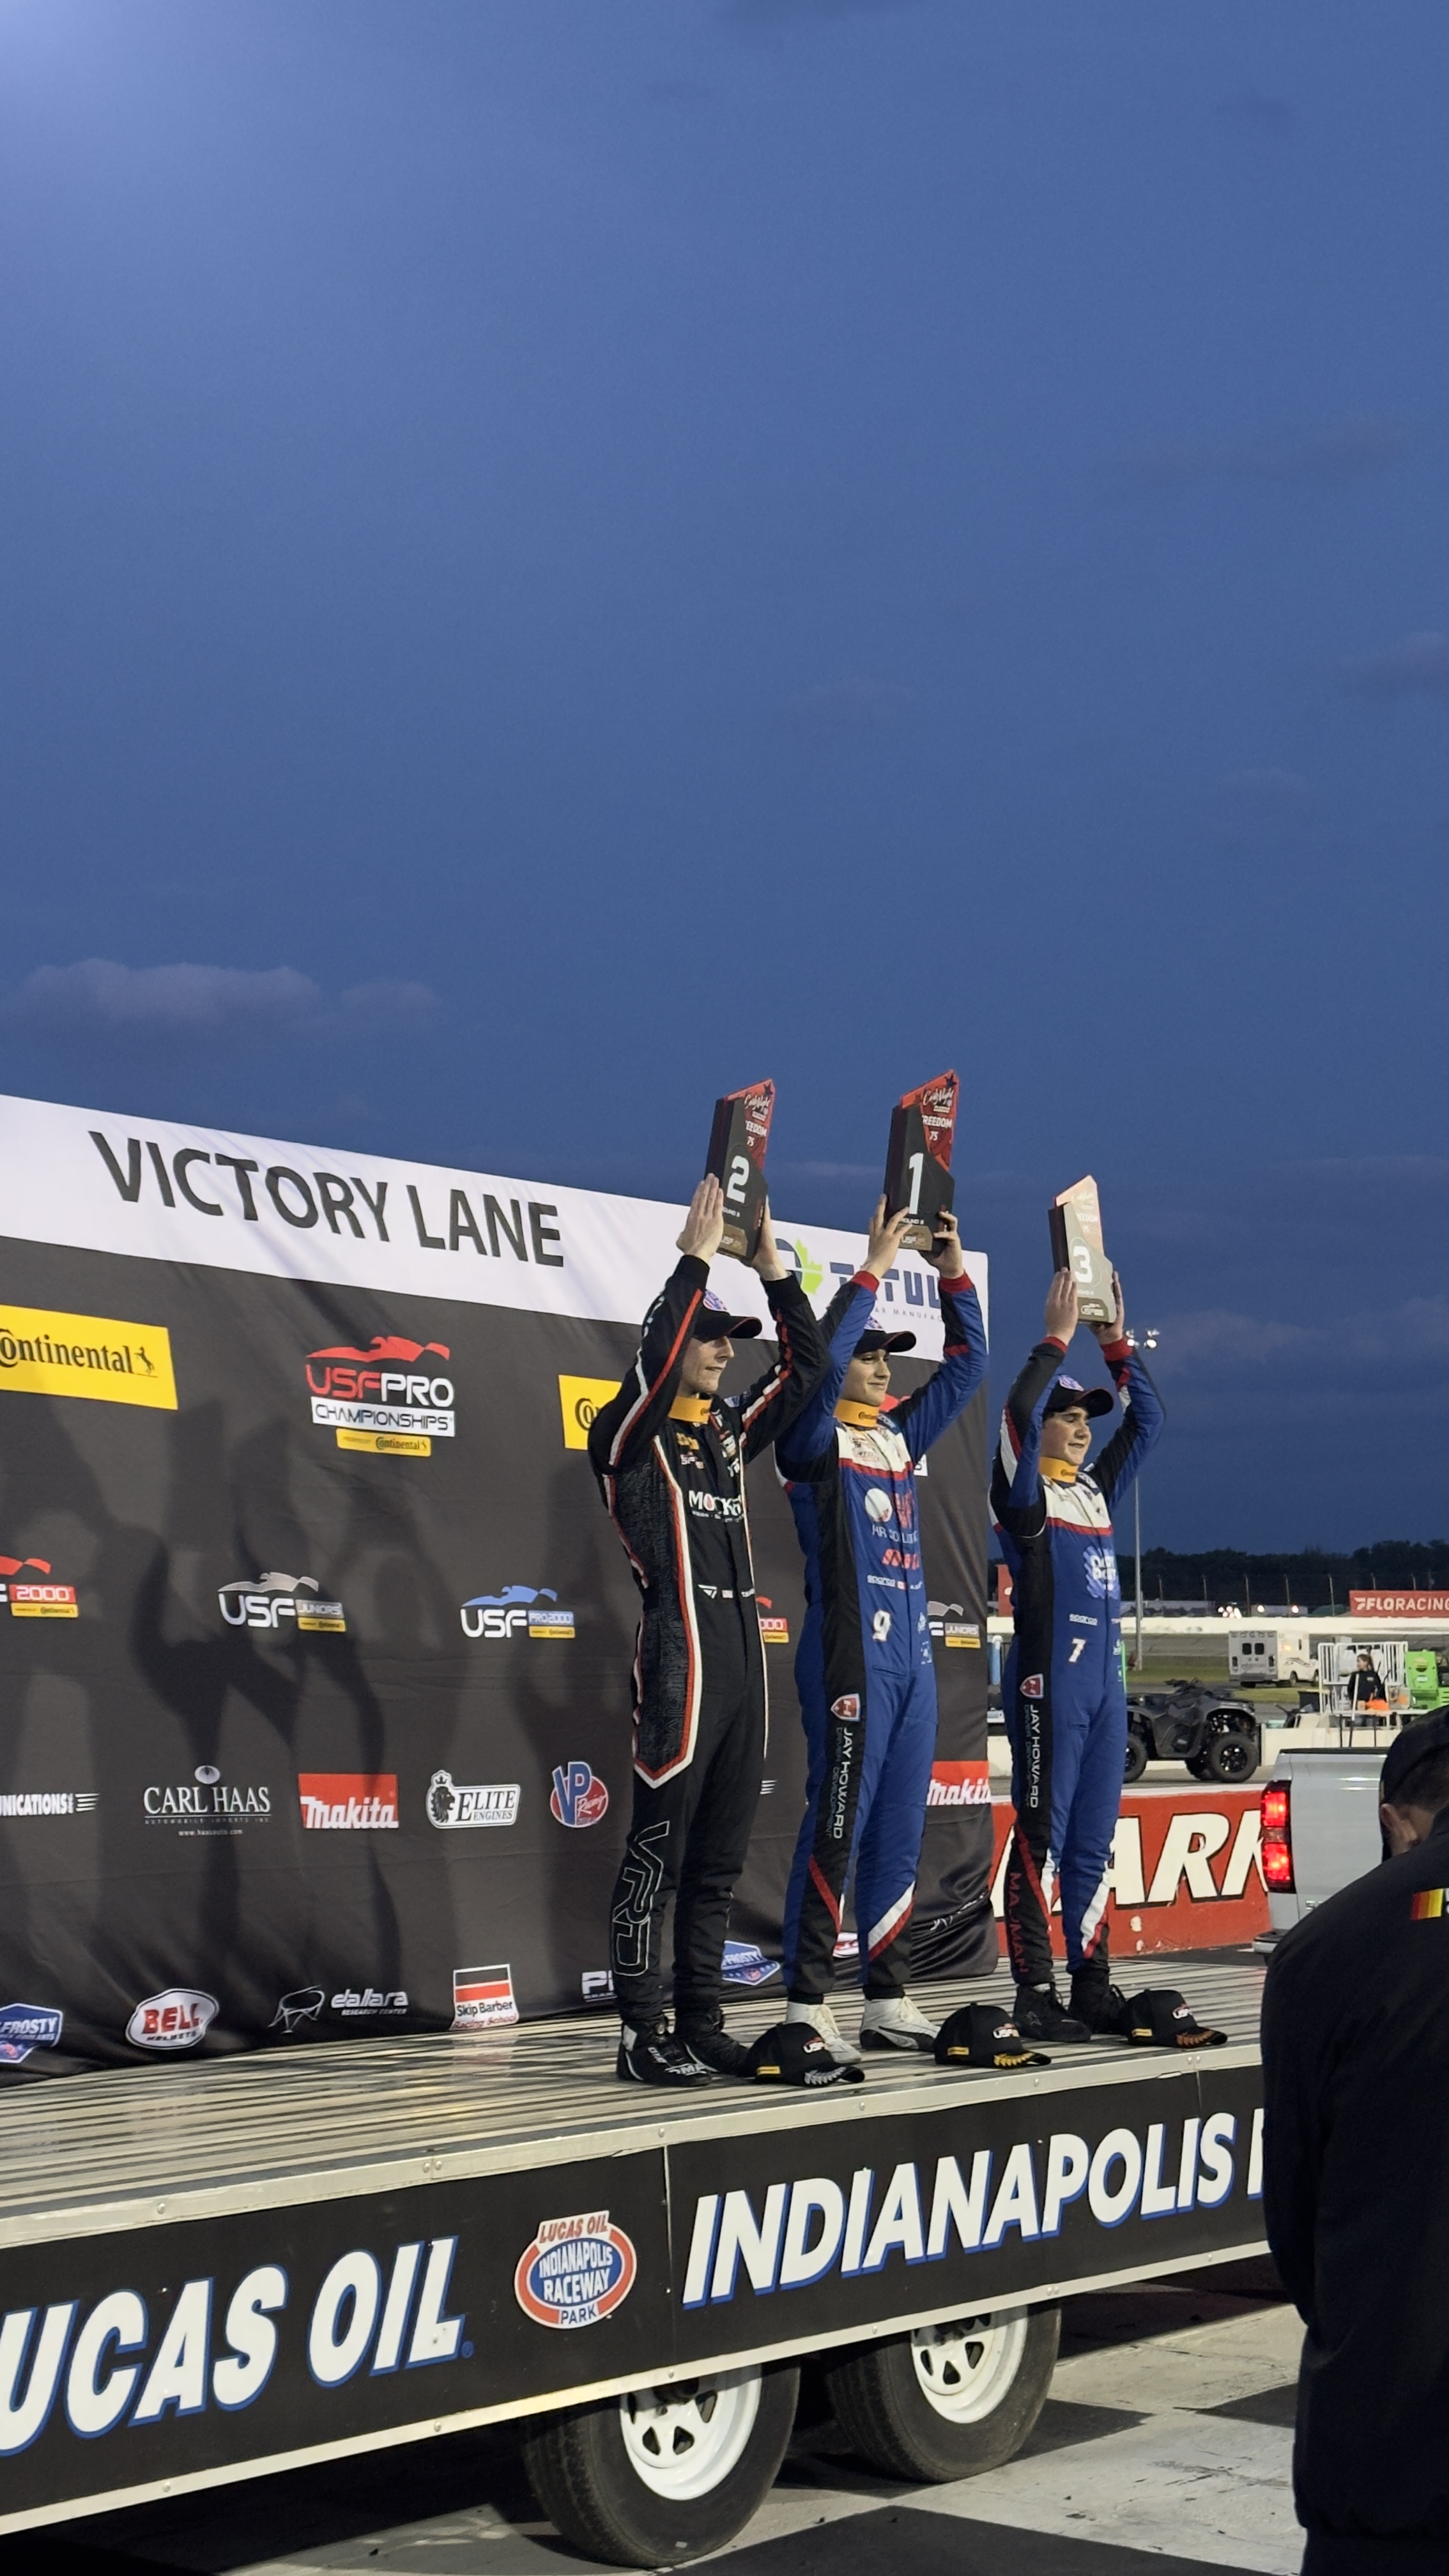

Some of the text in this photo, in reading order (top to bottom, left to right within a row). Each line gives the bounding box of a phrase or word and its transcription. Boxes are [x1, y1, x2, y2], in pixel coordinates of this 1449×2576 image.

[922, 1115, 953, 1129] REEDOM
[726, 1155, 750, 1204] 2
[908, 1153, 924, 1215] 1
[88, 1130, 565, 1268] VICTORY LANE
[1073, 1245, 1093, 1284] 3
[315, 1404, 449, 1430] CHAMPIONSHIPS
[376, 1436, 420, 1451] Continental
[16, 1586, 70, 1601] 2000
[218, 1593, 296, 1629] USF
[460, 1609, 528, 1638] USF
[873, 1609, 892, 1642] 9
[1069, 1637, 1087, 1662] 7
[1029, 1705, 1041, 1809] JAY HOWARD
[551, 1761, 592, 1827] VP
[833, 1727, 854, 1839] JAY HOWARD
[144, 1786, 271, 1814] CARL HAAS
[455, 1790, 517, 1821] ELITE
[473, 1809, 513, 1821] ENGINES
[331, 1988, 409, 2009] dallara
[456, 2000, 513, 2017] Skip Barber
[1, 2016, 58, 2034] FROSTY
[141, 2002, 200, 2035] BELL
[682, 2112, 1236, 2310] INDIANAPOLIS
[539, 2214, 608, 2243] LUCAS OIL
[539, 2241, 614, 2278] INDIANAPOLIS
[544, 2268, 611, 2304] RACEWAY
[307, 2235, 466, 2389] OIL
[560, 2304, 597, 2325] PARK
